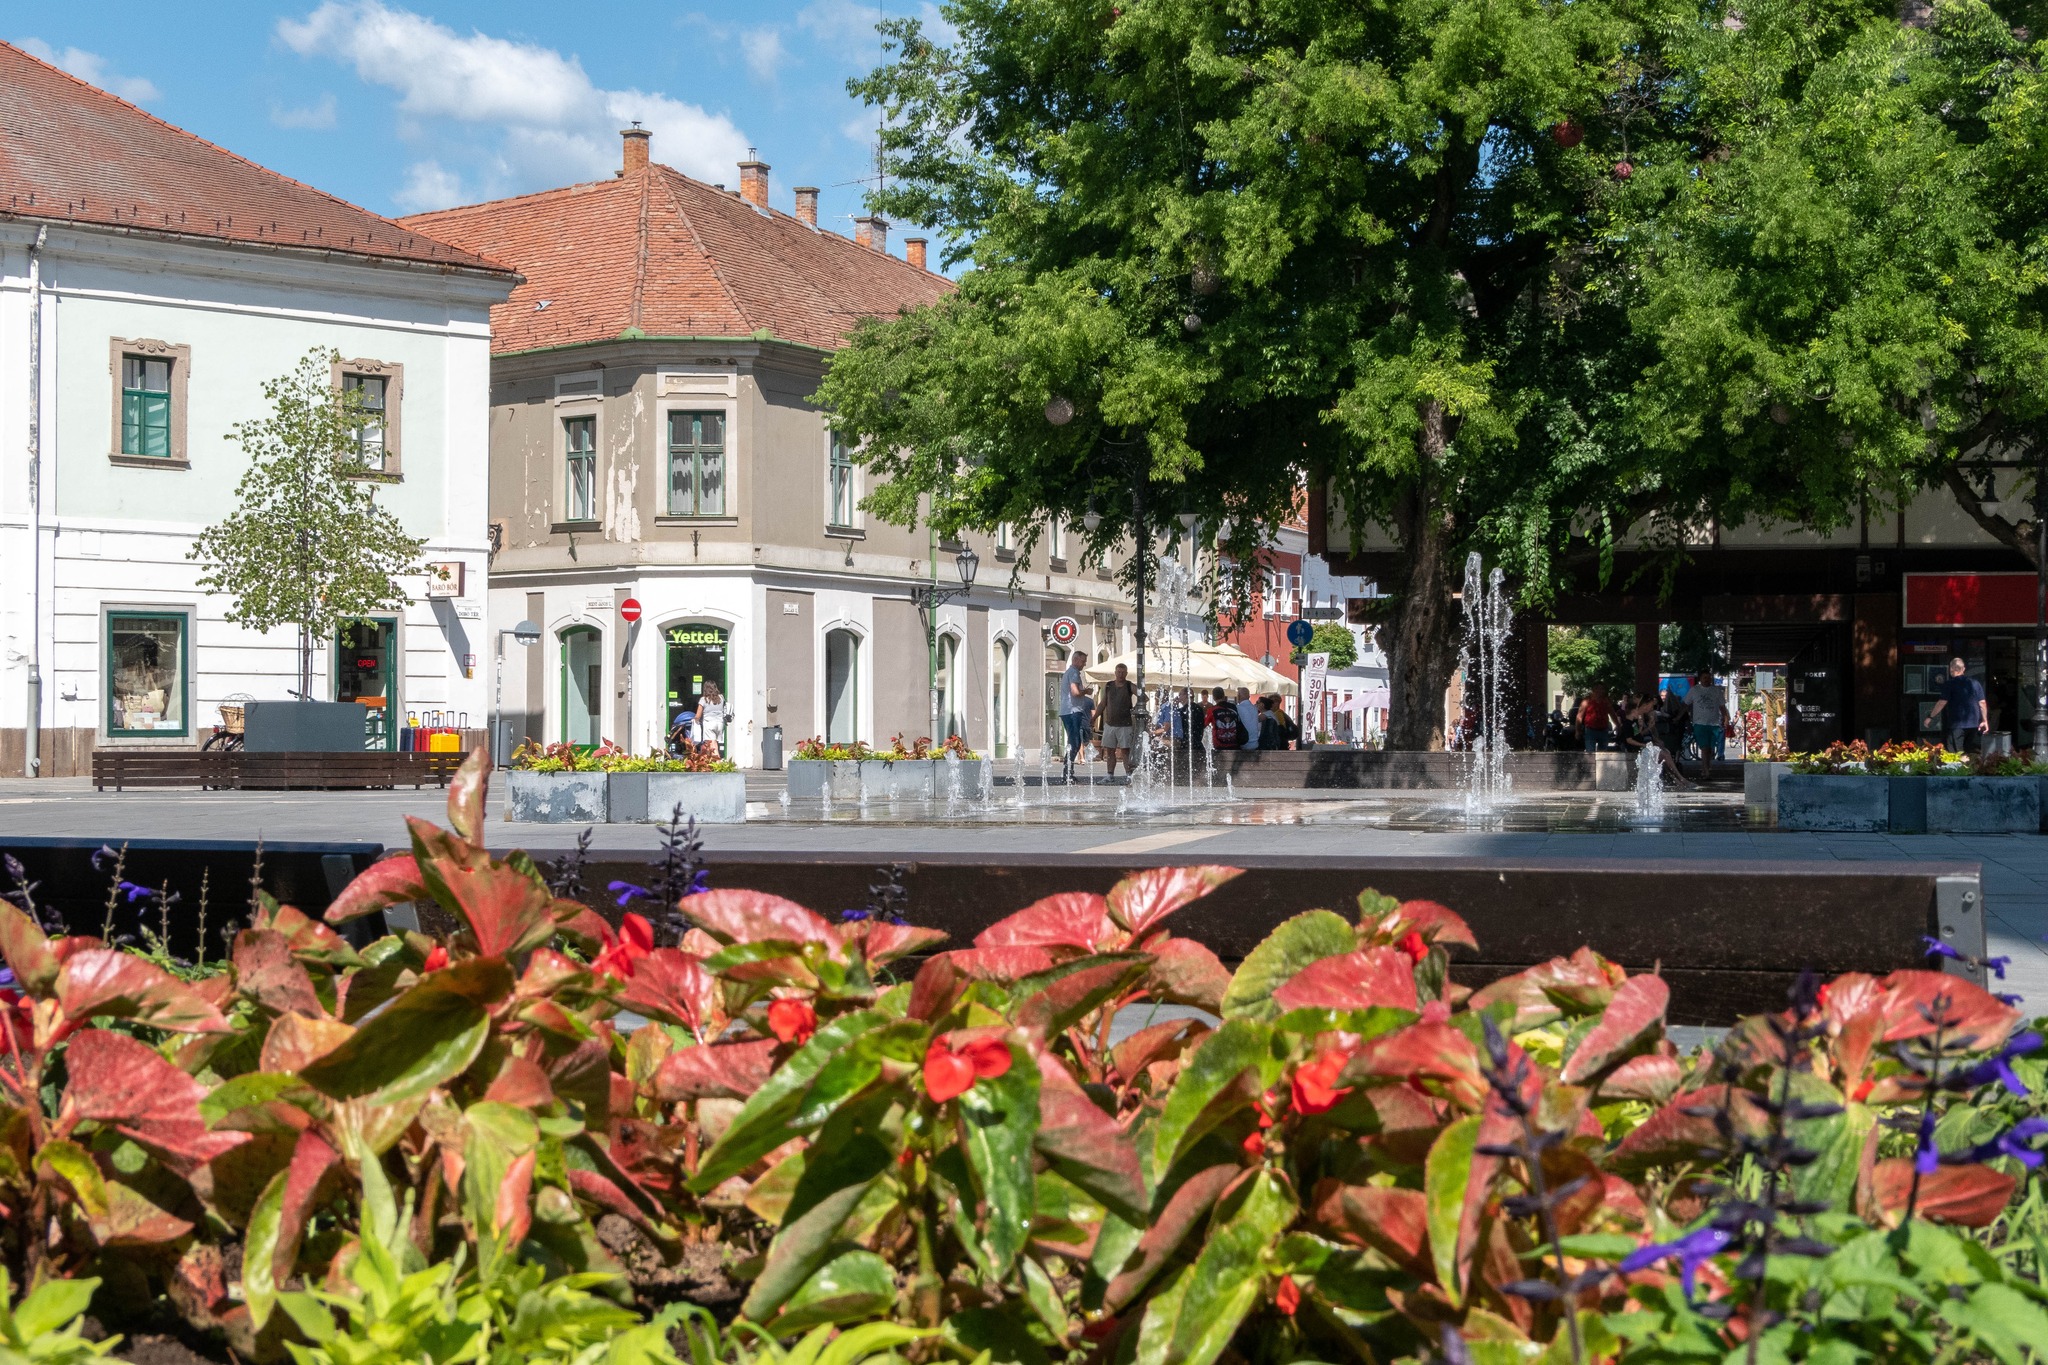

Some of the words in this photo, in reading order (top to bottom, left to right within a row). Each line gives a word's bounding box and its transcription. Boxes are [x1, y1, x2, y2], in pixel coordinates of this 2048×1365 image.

[670, 629, 723, 644] Yettel.
[357, 659, 376, 668] OPEN
[1312, 656, 1325, 667] POP
[1310, 679, 1321, 689] 30
